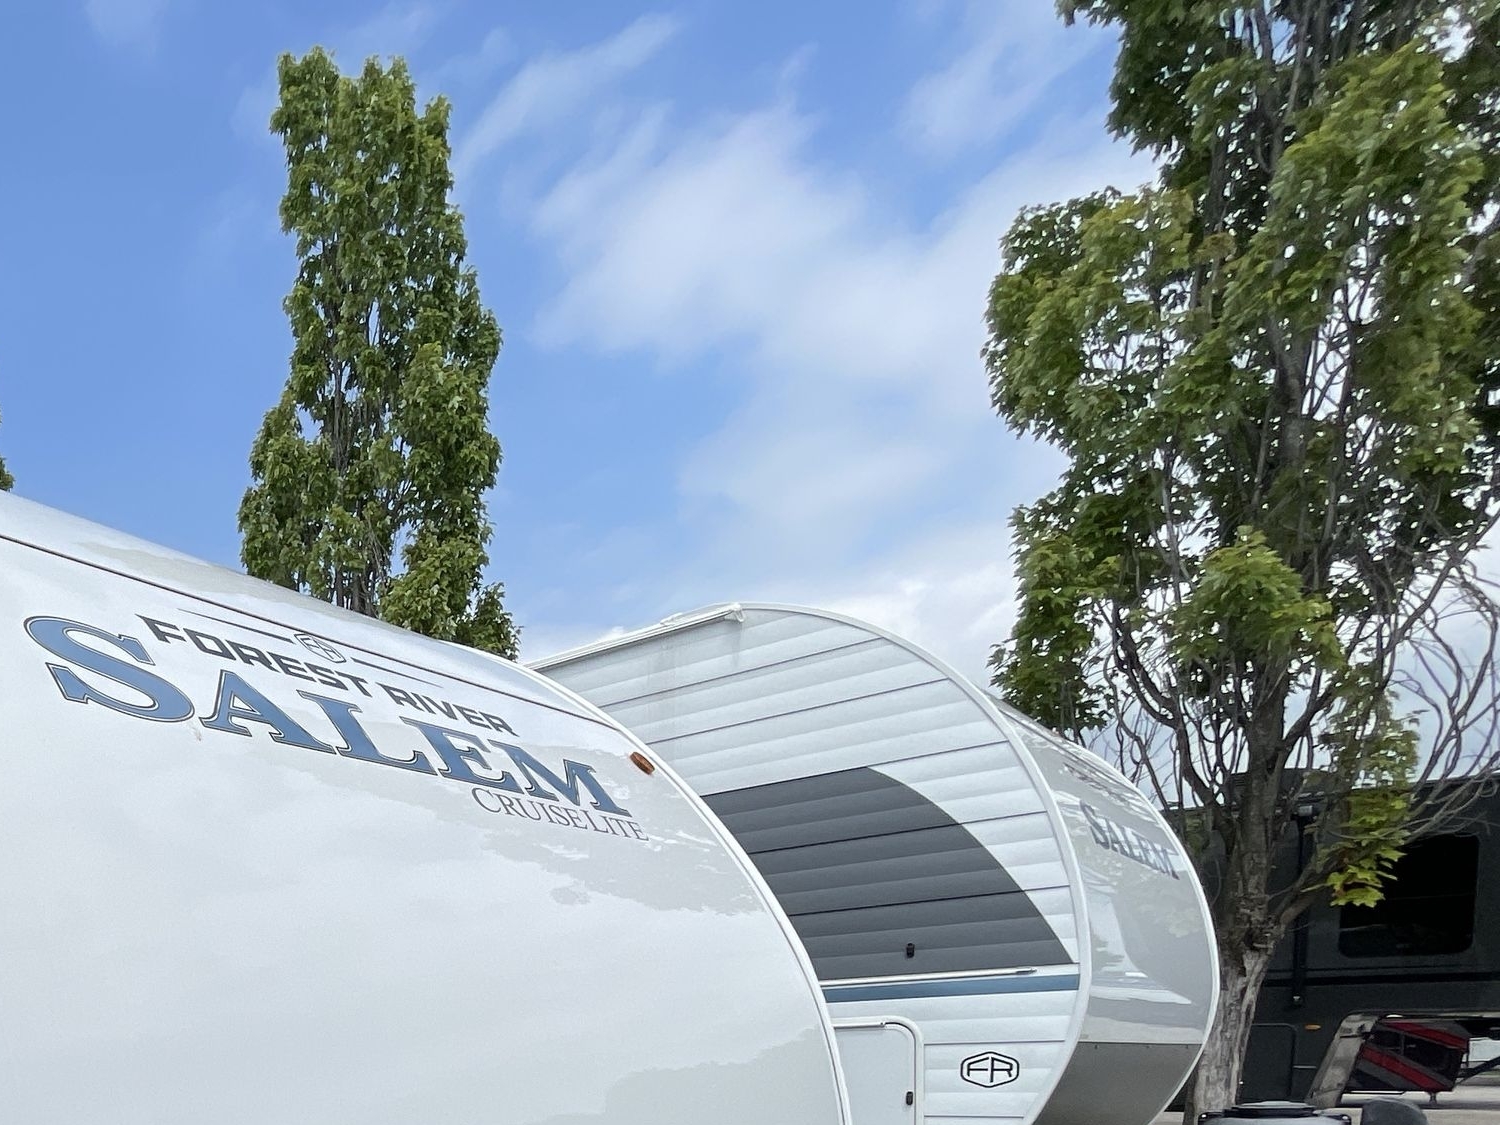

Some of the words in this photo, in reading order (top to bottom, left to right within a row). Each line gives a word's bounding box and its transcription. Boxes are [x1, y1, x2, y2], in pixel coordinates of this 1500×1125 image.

[23, 615, 632, 818] SALEM
[136, 614, 373, 697] FOREST
[377, 683, 519, 736] RIVER
[1080, 799, 1180, 881] SALEM
[965, 1055, 1015, 1084] FR
